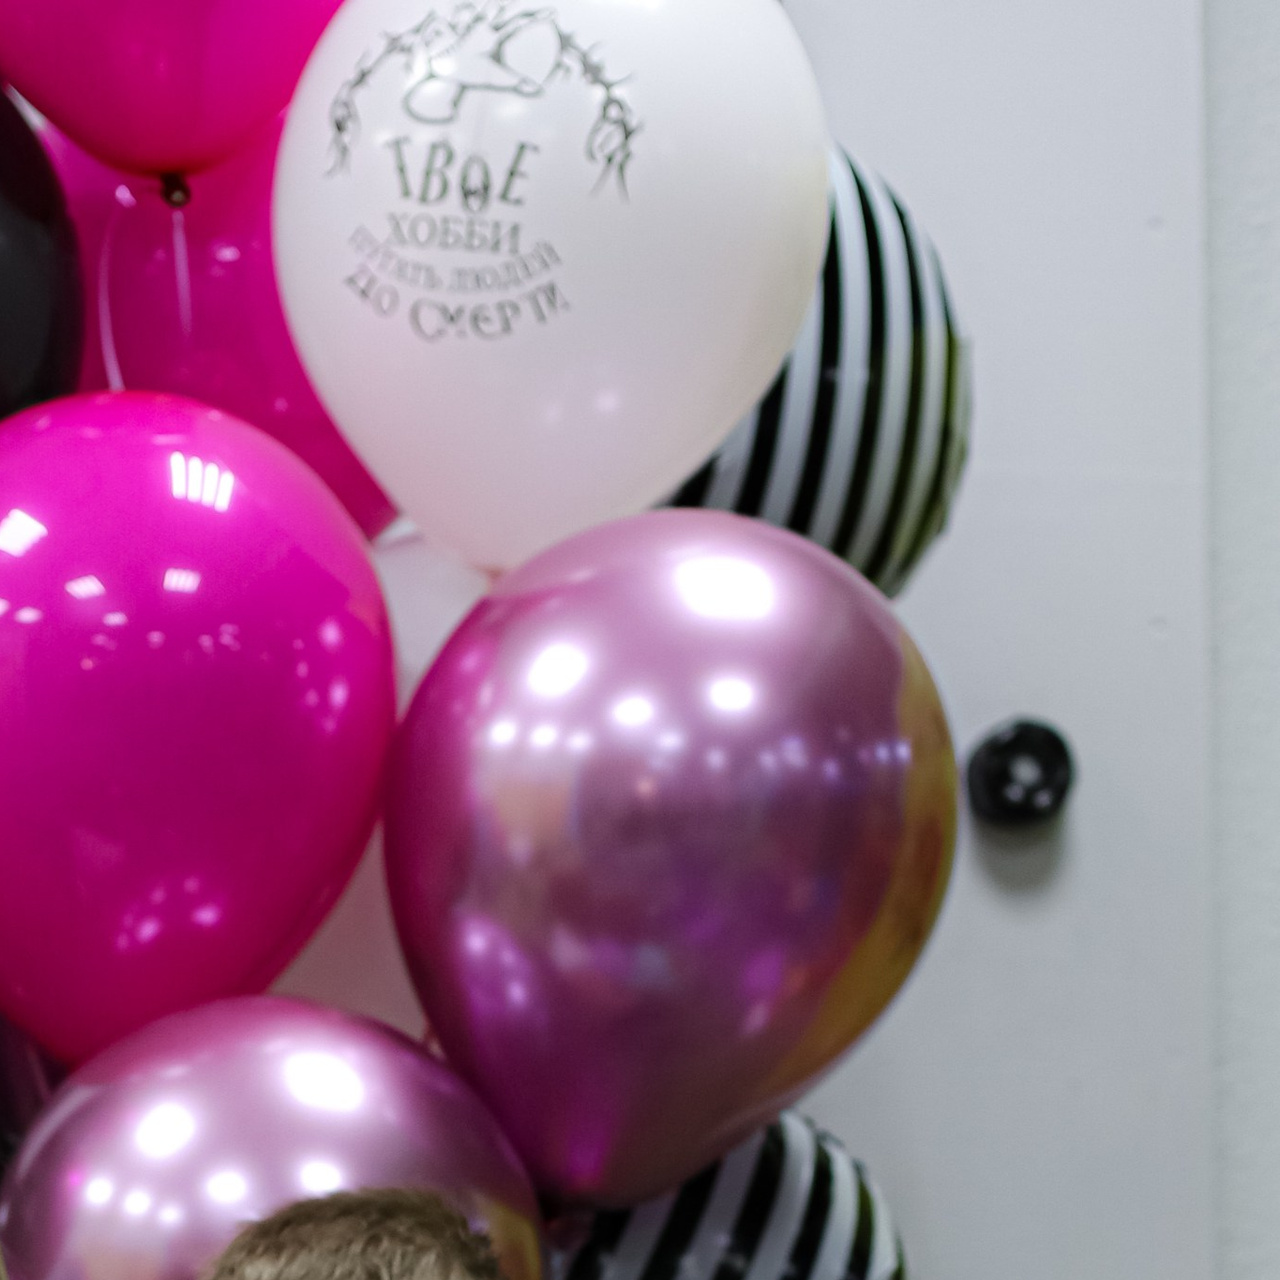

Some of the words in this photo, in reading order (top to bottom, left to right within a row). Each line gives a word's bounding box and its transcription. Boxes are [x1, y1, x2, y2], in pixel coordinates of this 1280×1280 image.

[384, 135, 540, 213] ТВОЕ
[380, 211, 521, 255] ХОББИ
[342, 262, 400, 319] ДО
